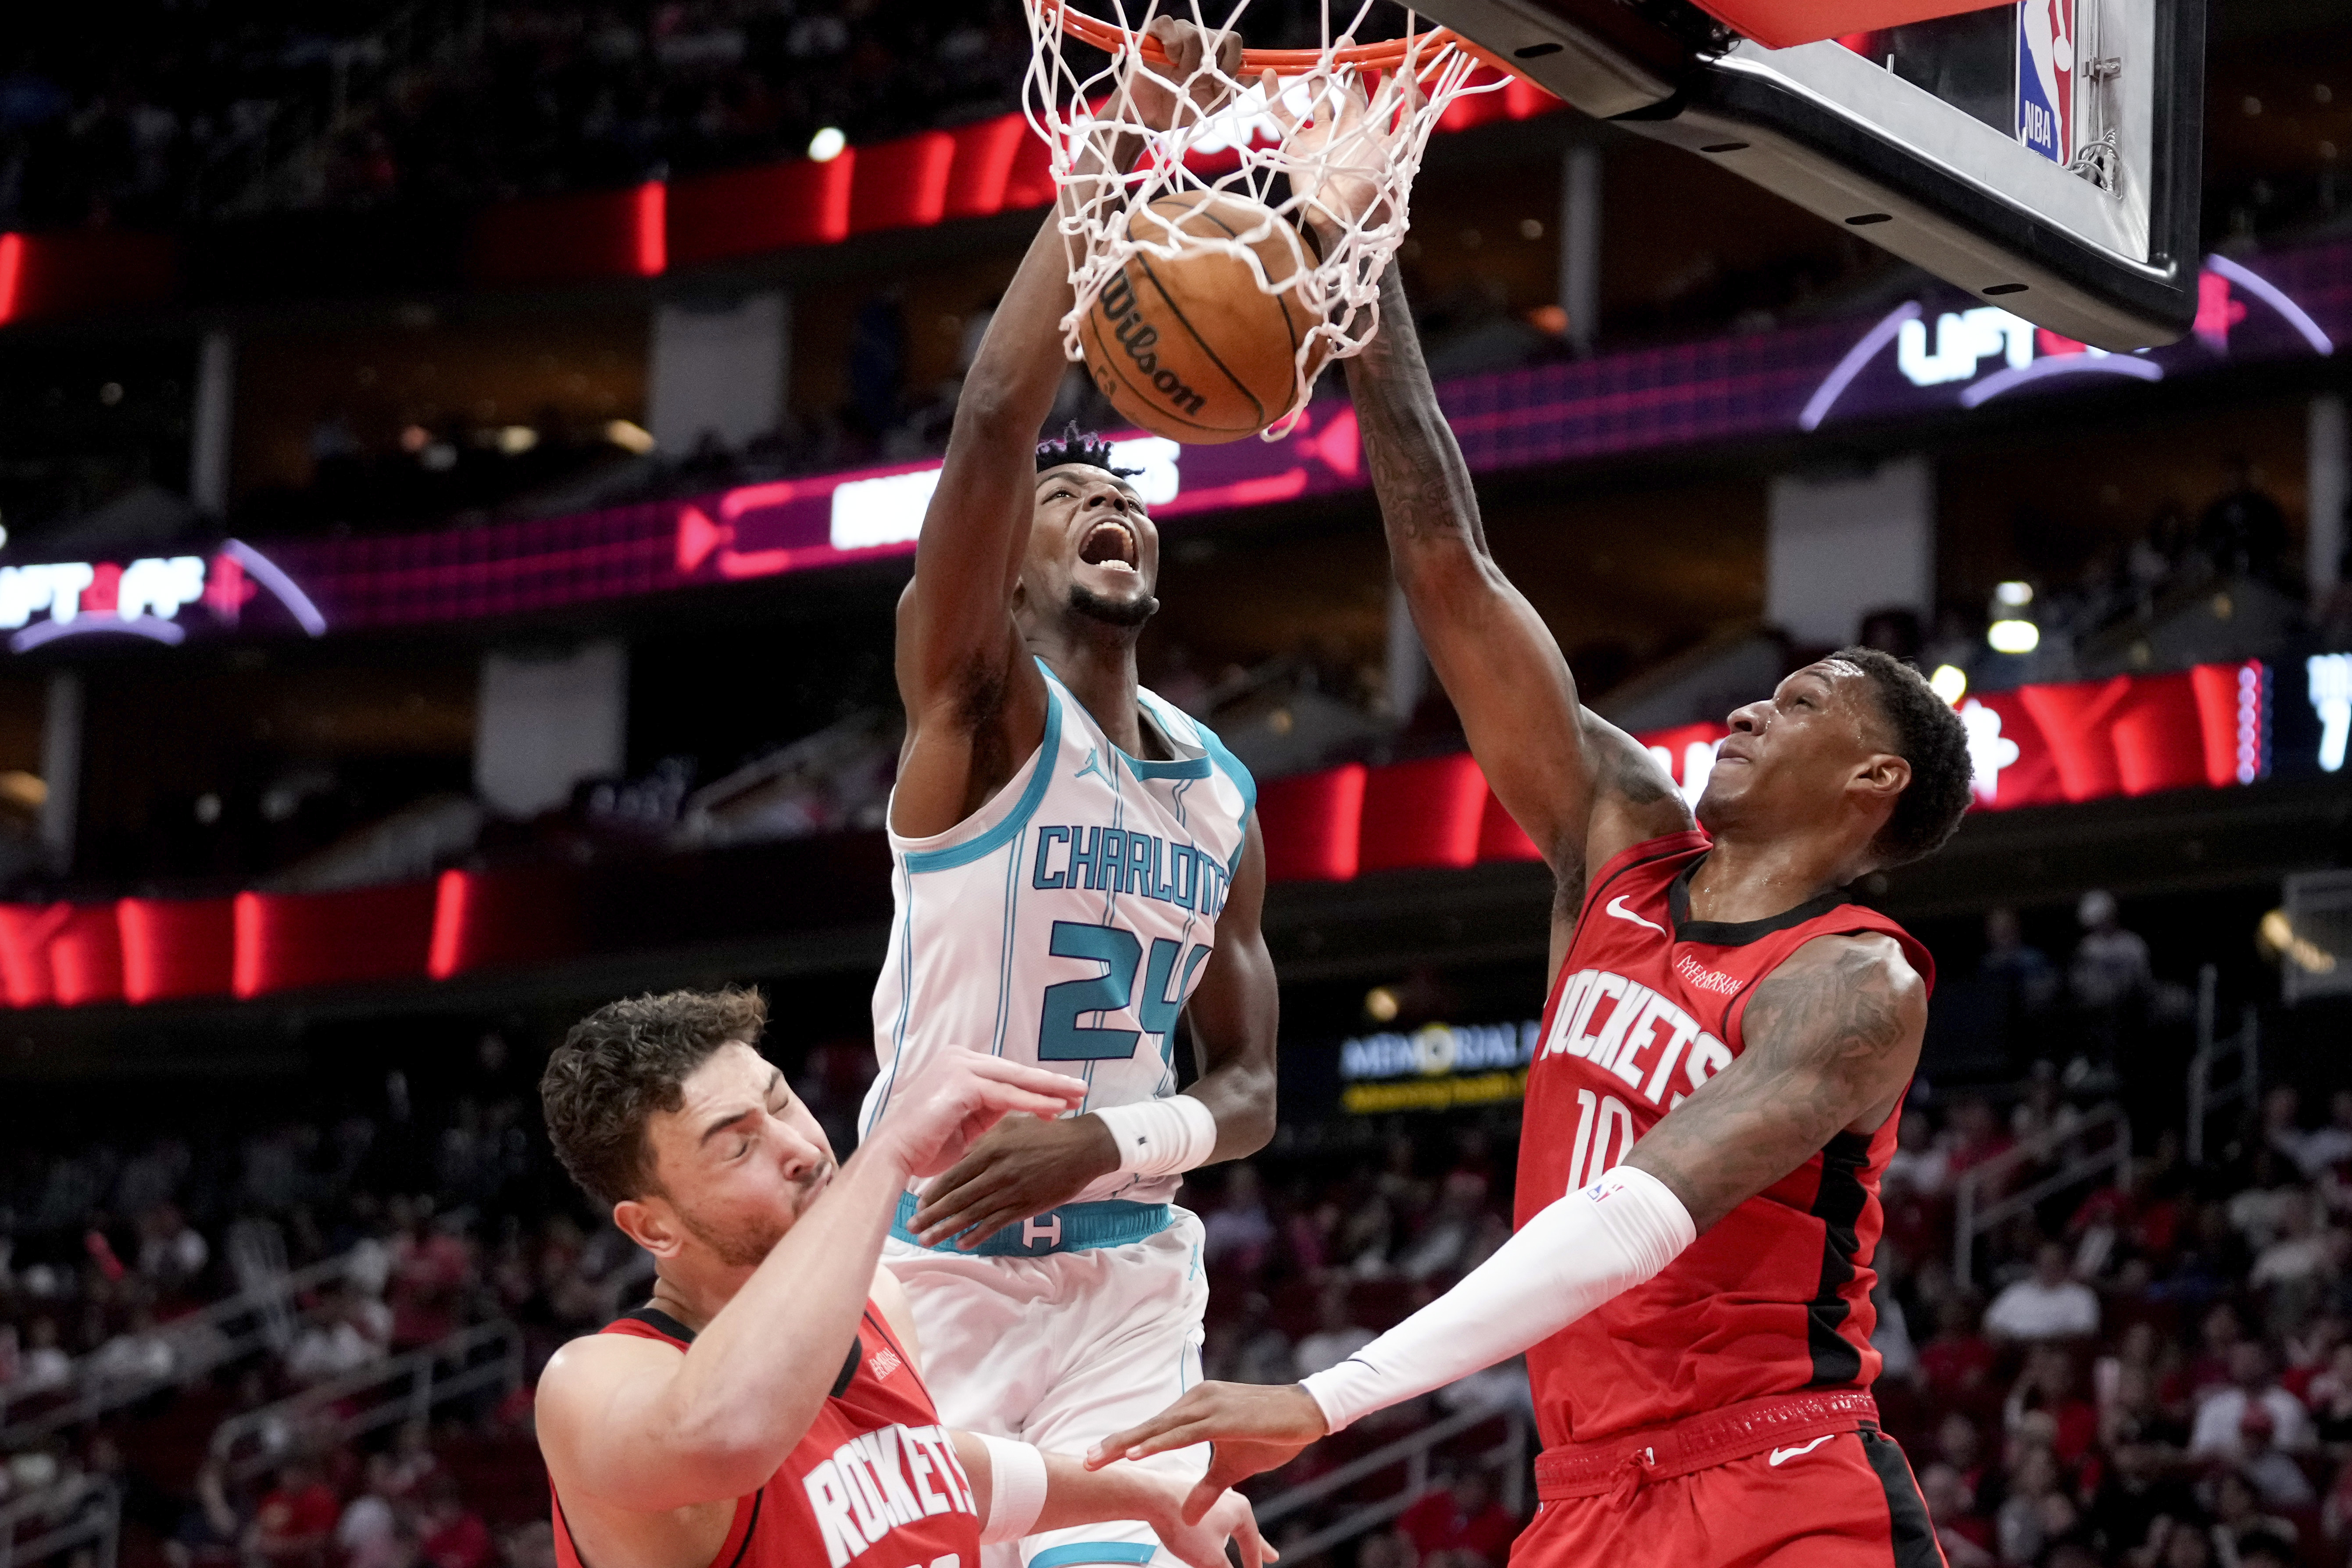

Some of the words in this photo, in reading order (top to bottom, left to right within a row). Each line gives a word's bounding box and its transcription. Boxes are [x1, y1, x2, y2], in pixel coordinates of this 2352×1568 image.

[2024, 100, 2051, 149] NBA
[1099, 267, 1206, 415] Wilson
[1038, 920, 1214, 1069] 24
[1682, 954, 1743, 989] MEMORIAL
[1539, 968, 1733, 1111] OCKETS
[1566, 1088, 1634, 1197] 10
